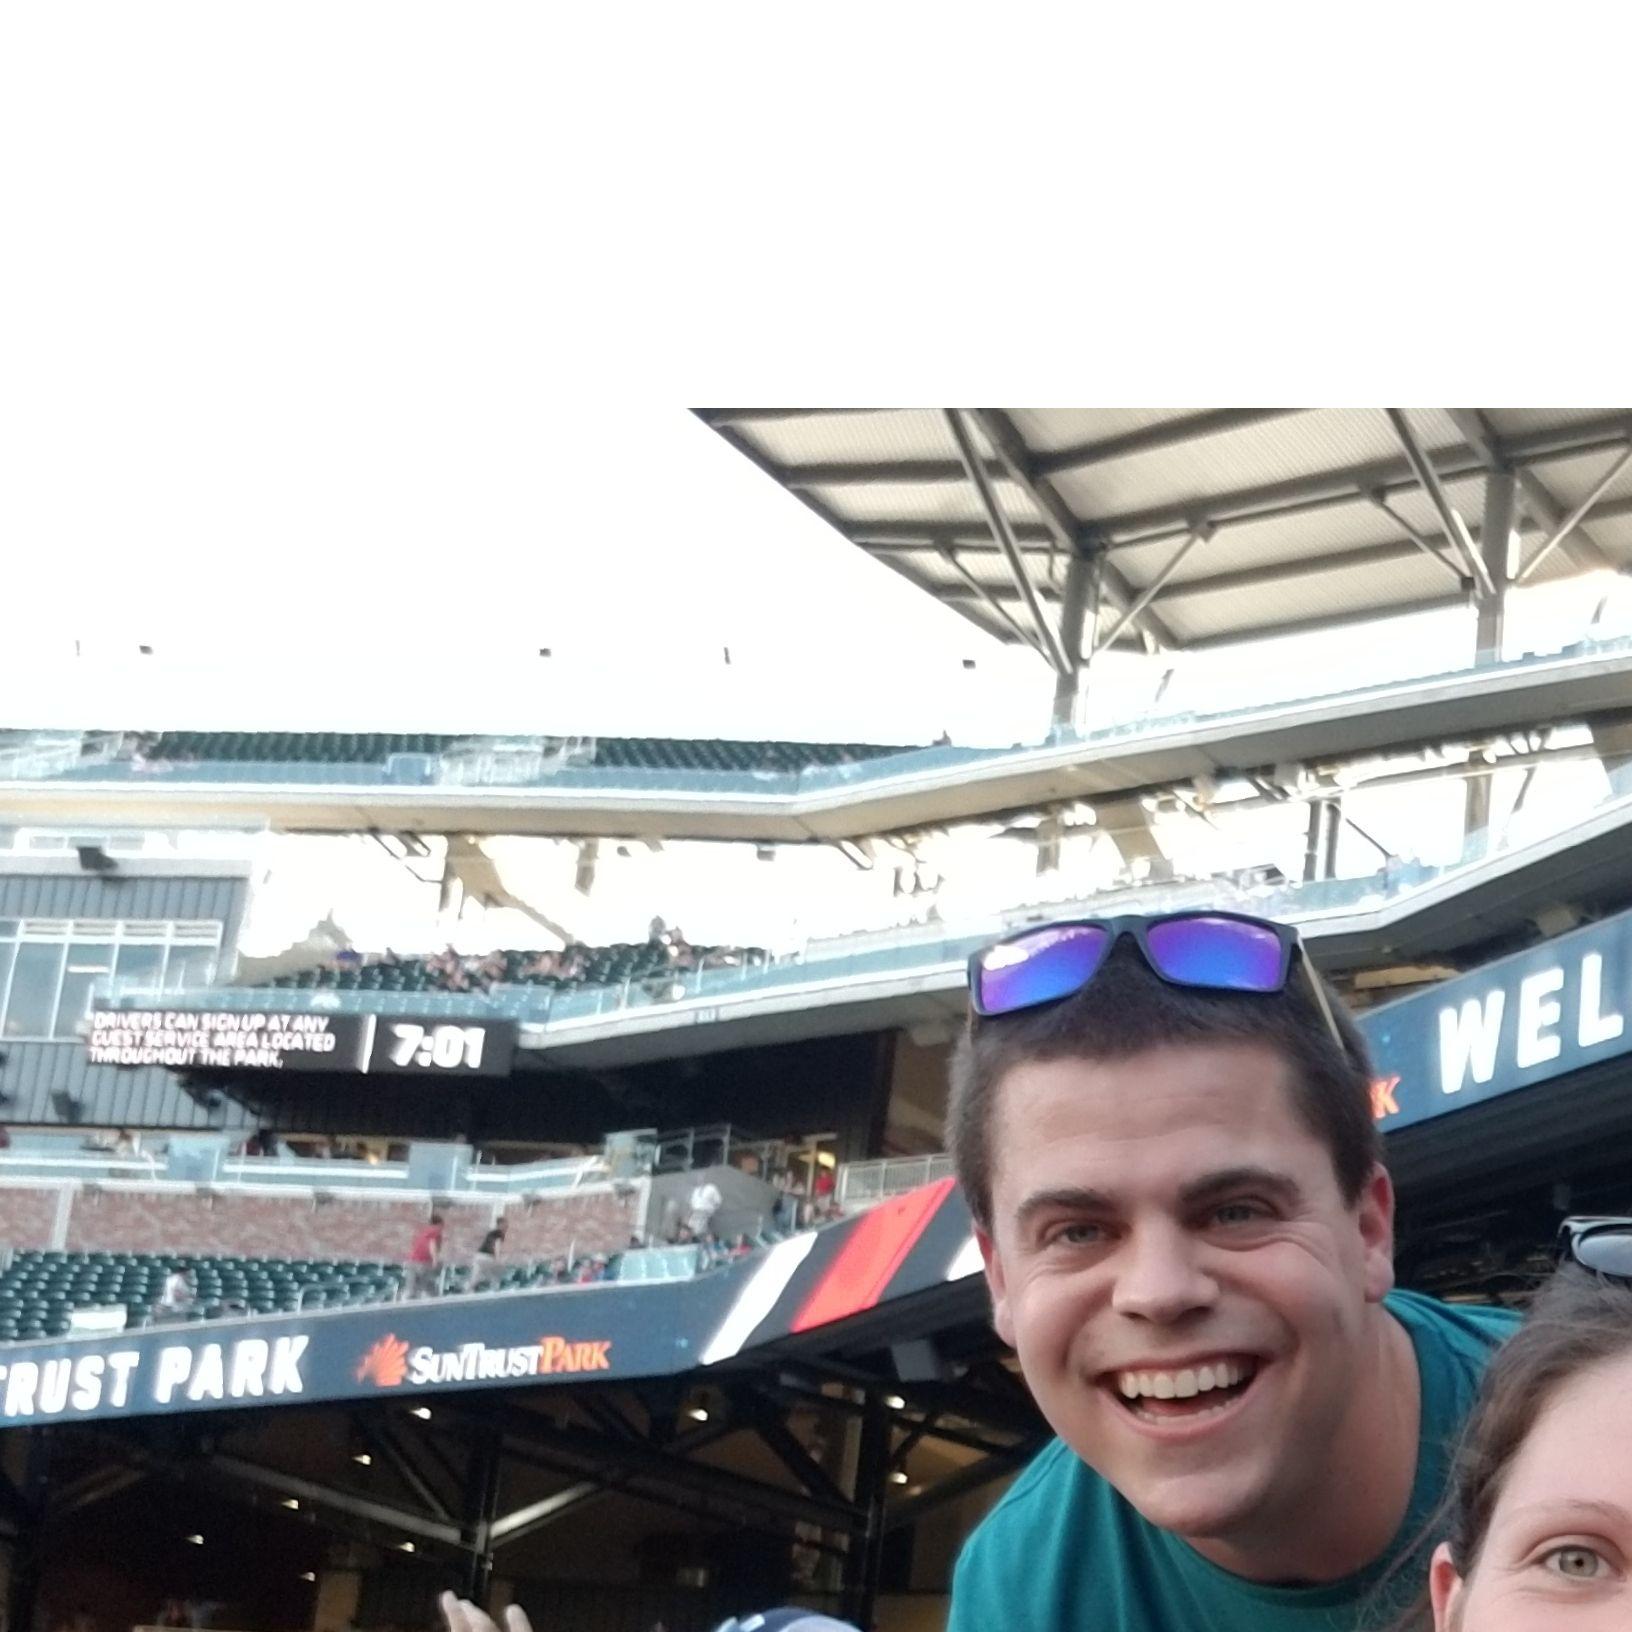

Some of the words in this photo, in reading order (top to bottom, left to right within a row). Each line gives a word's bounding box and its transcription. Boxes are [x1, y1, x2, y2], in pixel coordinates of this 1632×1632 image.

[164, 1012, 199, 1030] CAN
[201, 1012, 241, 1032] SIGN
[241, 1013, 266, 1032] UP
[267, 1014, 292, 1032] AT
[293, 1015, 330, 1033] ANY
[92, 1029, 143, 1047] GUEST
[144, 1030, 210, 1048] SERVICE
[213, 1031, 259, 1050] AREA
[261, 1032, 336, 1052] LOCATED
[390, 1023, 486, 1068] 7:01
[90, 1046, 197, 1065] THROUGHOUT
[200, 1048, 232, 1066] THE
[155, 1335, 309, 1404] PARK
